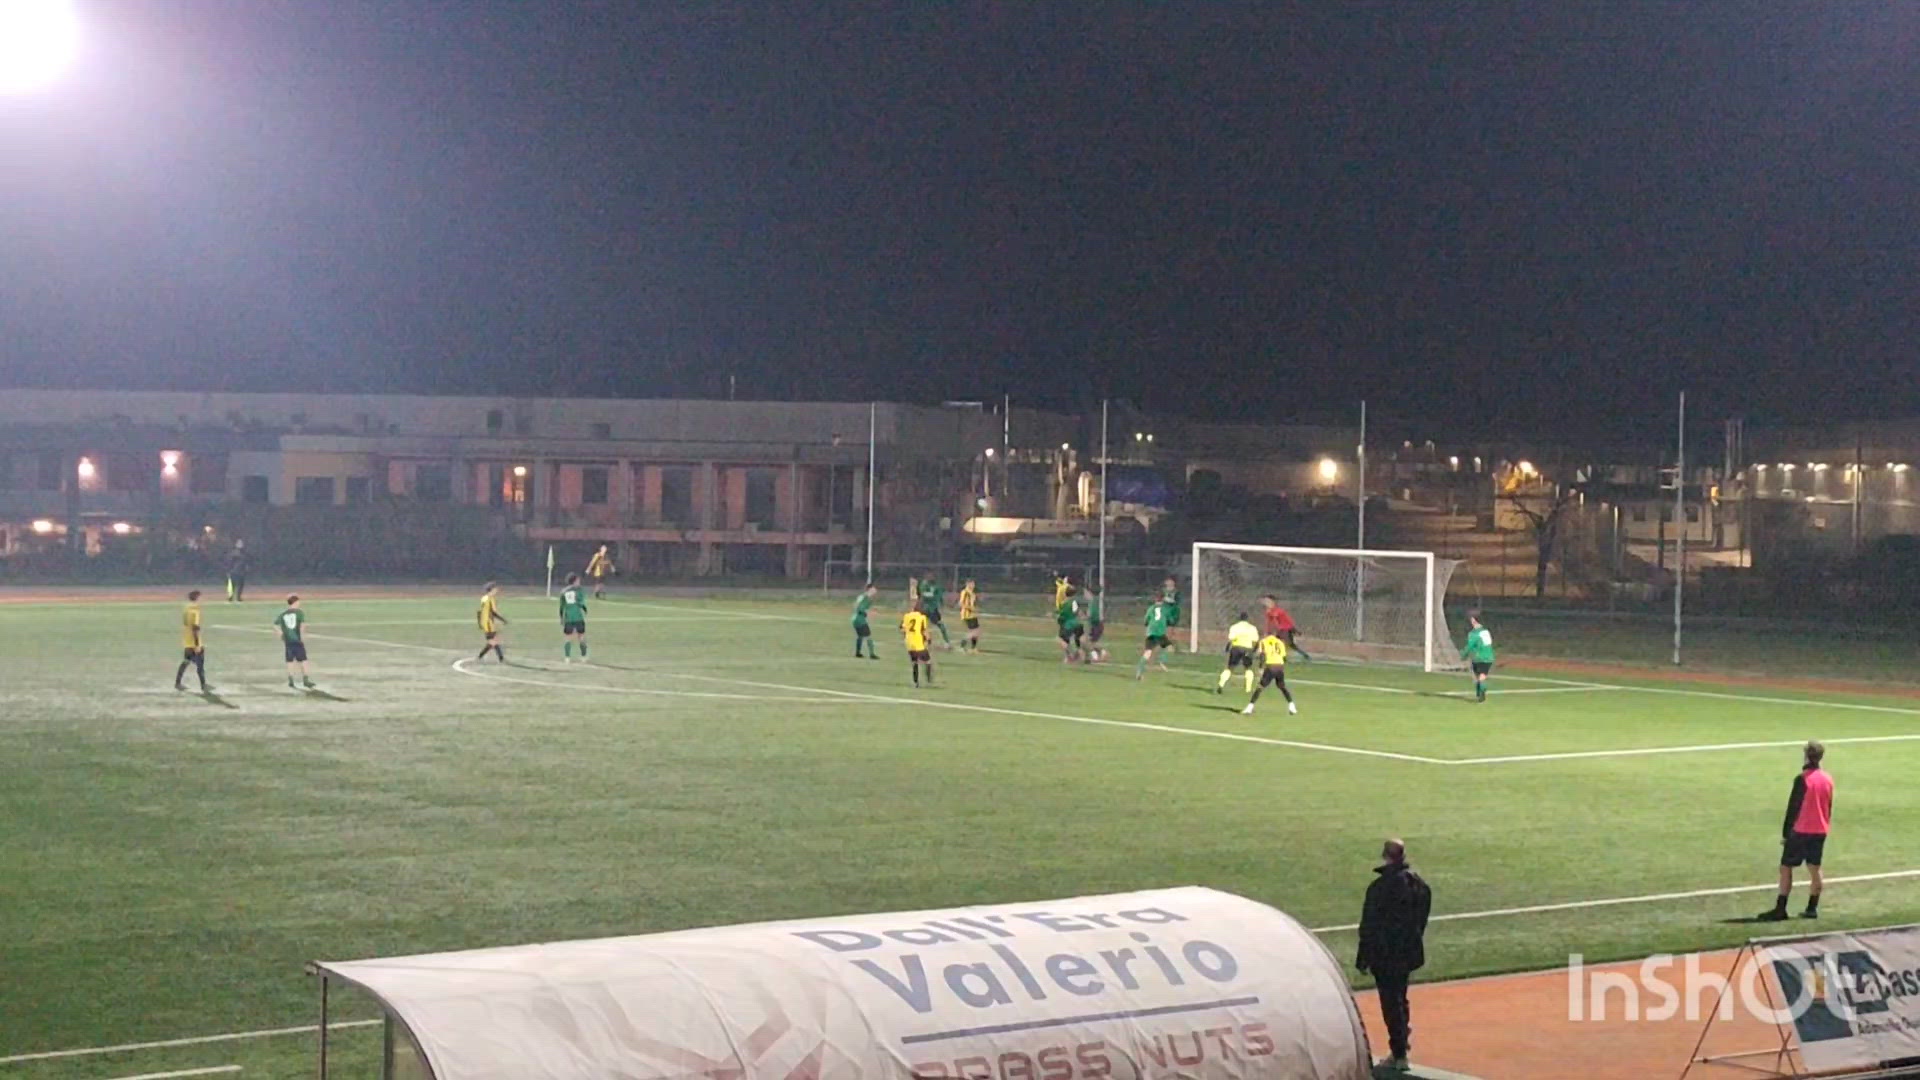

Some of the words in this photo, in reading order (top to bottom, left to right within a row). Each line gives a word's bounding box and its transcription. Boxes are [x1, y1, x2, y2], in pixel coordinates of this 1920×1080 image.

[908, 618, 917, 633] 2
[788, 915, 1016, 952] Dall'
[1011, 907, 1189, 932] Era
[849, 933, 1239, 1014] Valerio
[1137, 1022, 1275, 1070] NUTS
